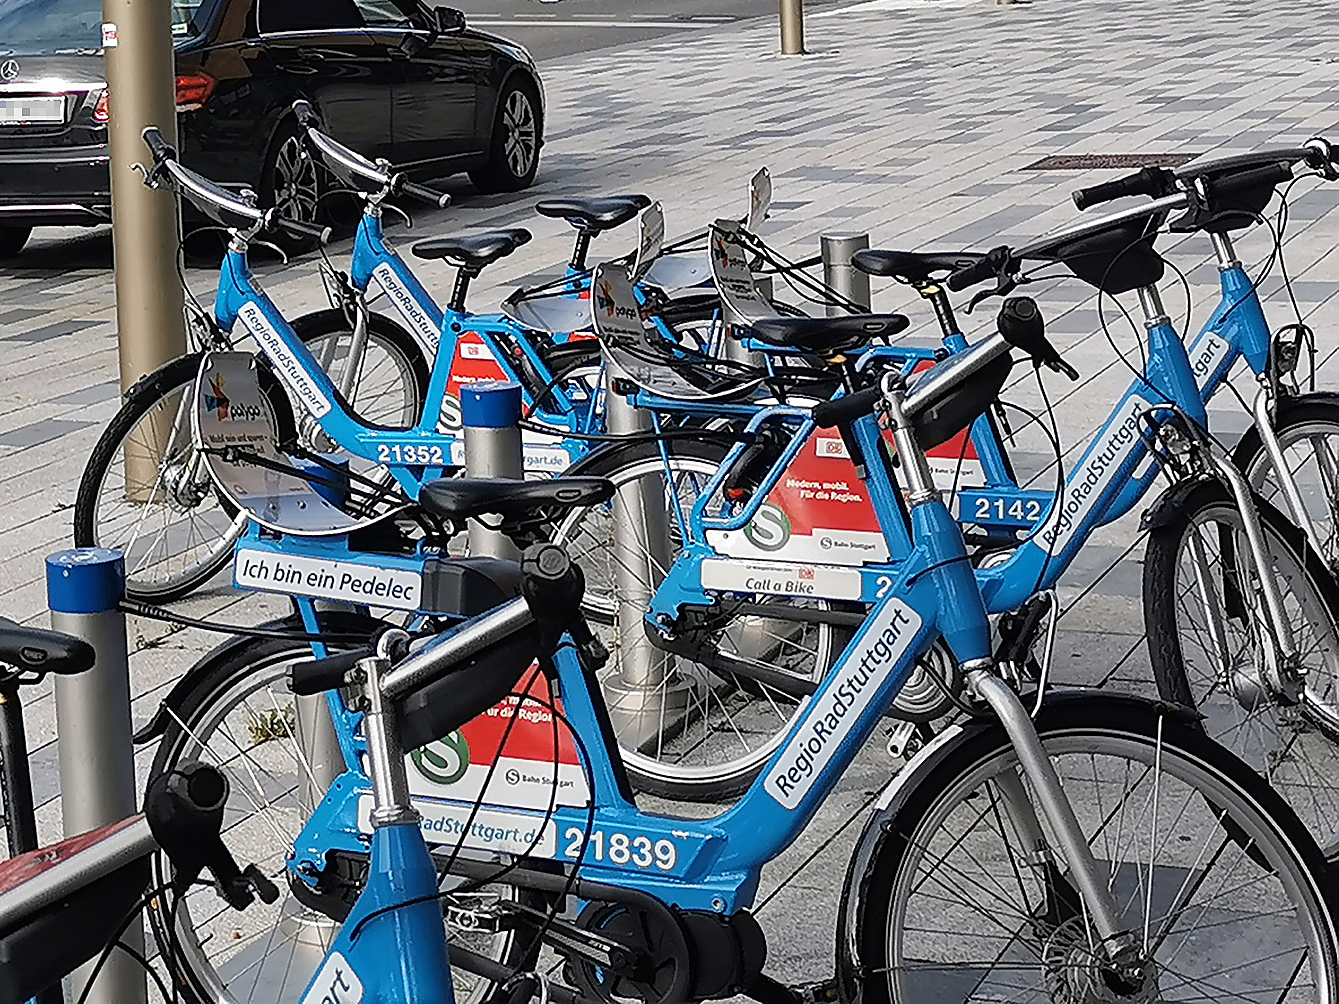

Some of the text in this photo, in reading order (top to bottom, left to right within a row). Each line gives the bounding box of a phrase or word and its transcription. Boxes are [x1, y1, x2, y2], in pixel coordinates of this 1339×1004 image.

[244, 308, 325, 412] RegioRadStuttgart
[230, 404, 261, 421] polygo
[377, 444, 444, 464] 21352
[974, 497, 1041, 521] 2142
[242, 558, 414, 601] Ich bin ein Pedelec
[745, 577, 814, 594] Call a Bike
[775, 608, 910, 798] RegioRadStuttgart
[522, 774, 540, 784] Bahn
[564, 827, 677, 871] 21839
